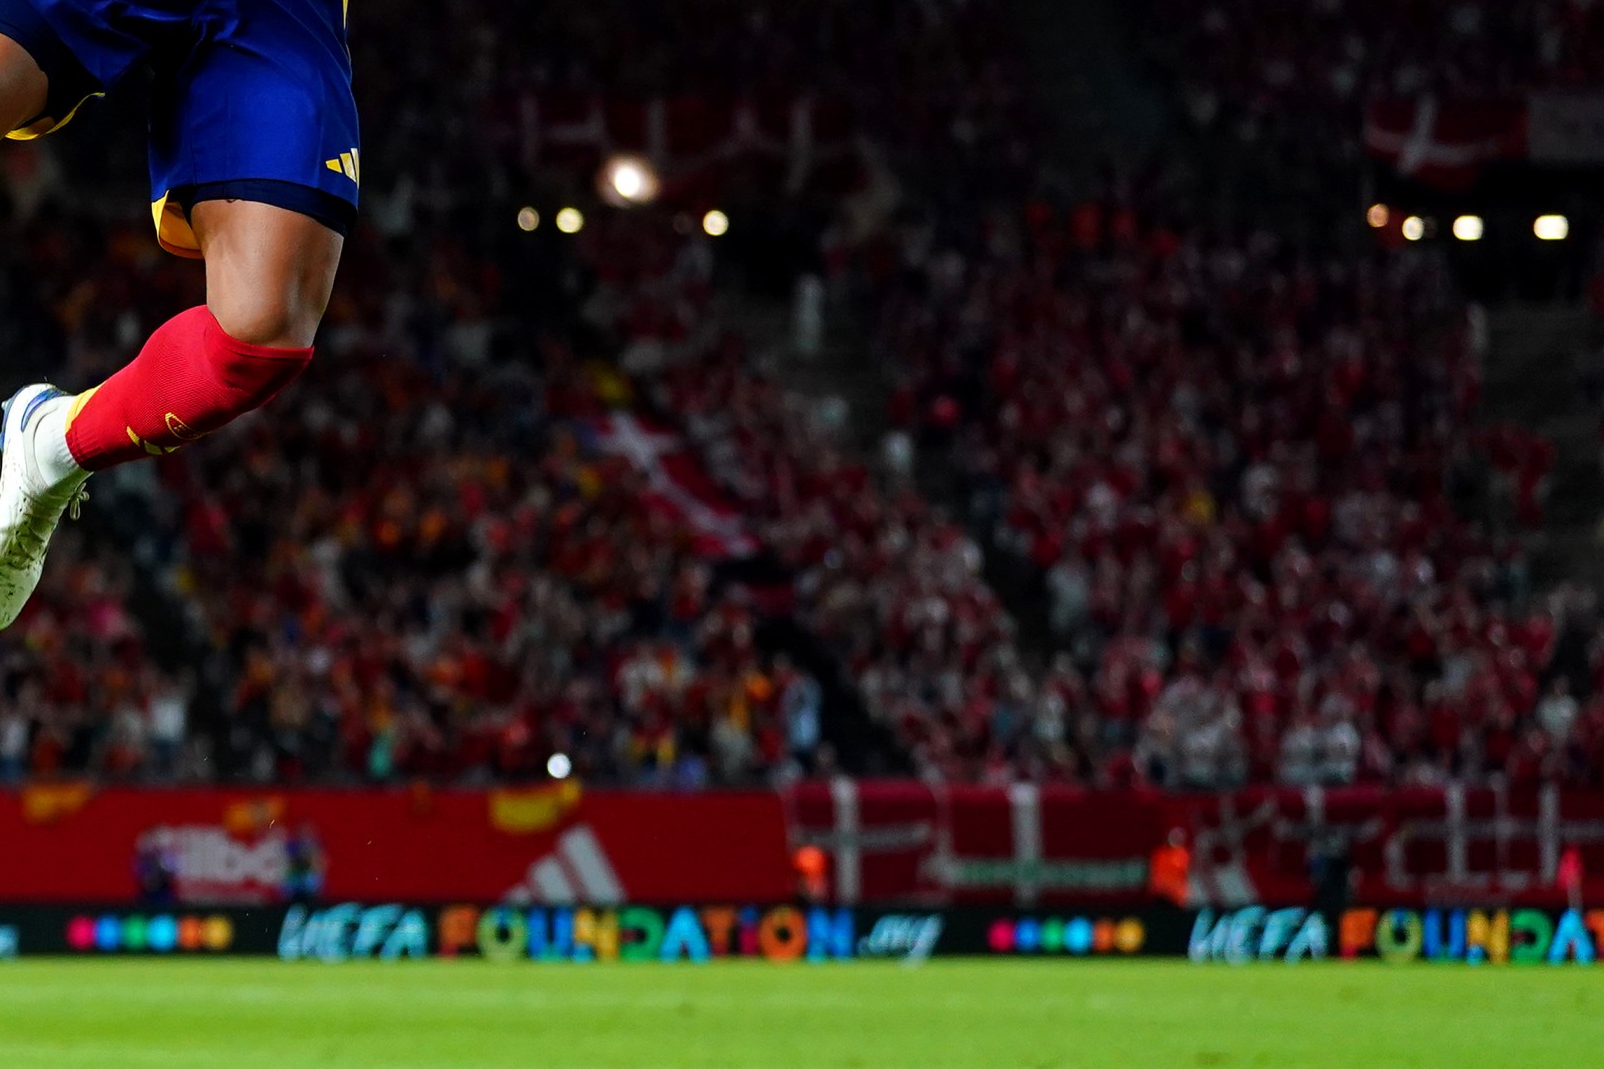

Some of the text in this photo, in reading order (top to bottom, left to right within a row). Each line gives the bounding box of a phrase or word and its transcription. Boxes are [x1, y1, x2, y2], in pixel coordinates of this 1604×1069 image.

[277, 902, 426, 964] UEFA
[439, 904, 854, 964] FOUNDATION
[1188, 904, 1328, 966] UEFA
